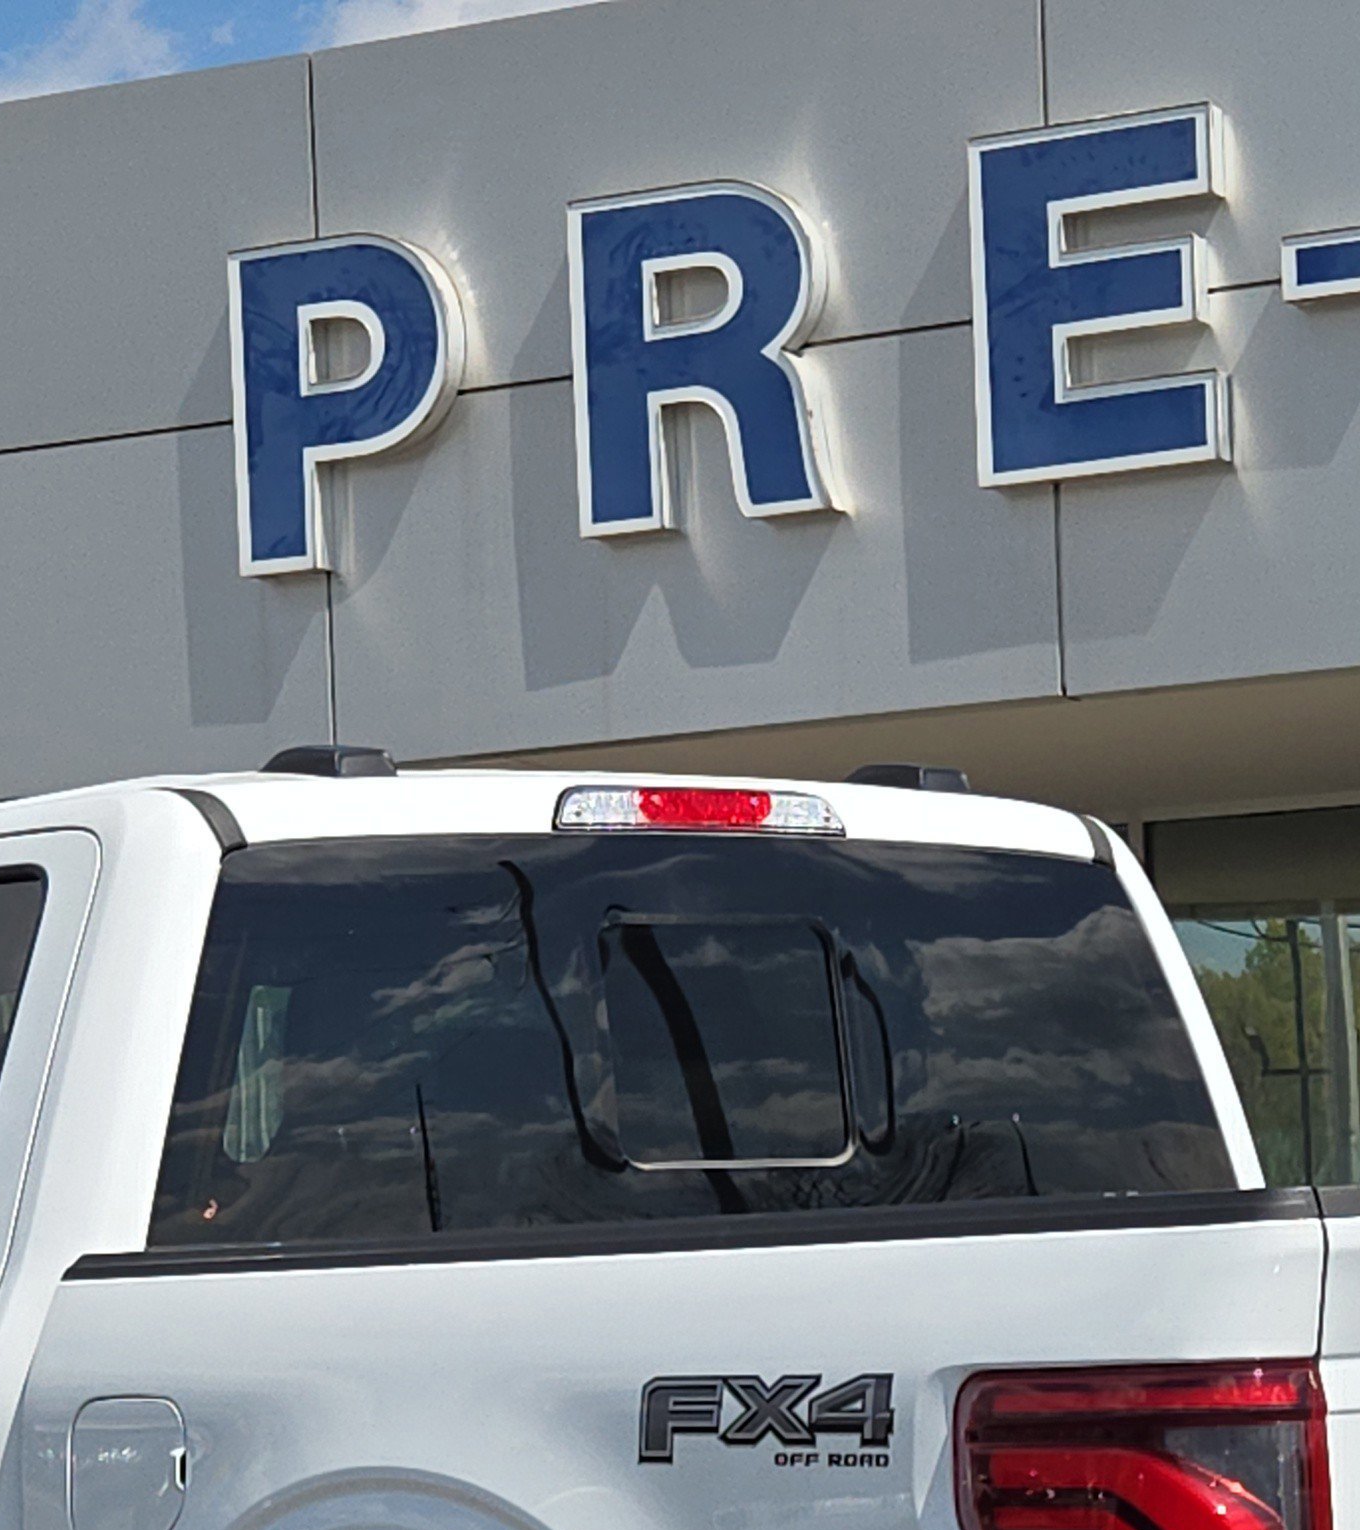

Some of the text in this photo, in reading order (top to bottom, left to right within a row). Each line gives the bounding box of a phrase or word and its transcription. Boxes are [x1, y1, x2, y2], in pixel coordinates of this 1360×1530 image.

[638, 1373, 894, 1464] FX4
[773, 1452, 890, 1467] OFF ROAD
